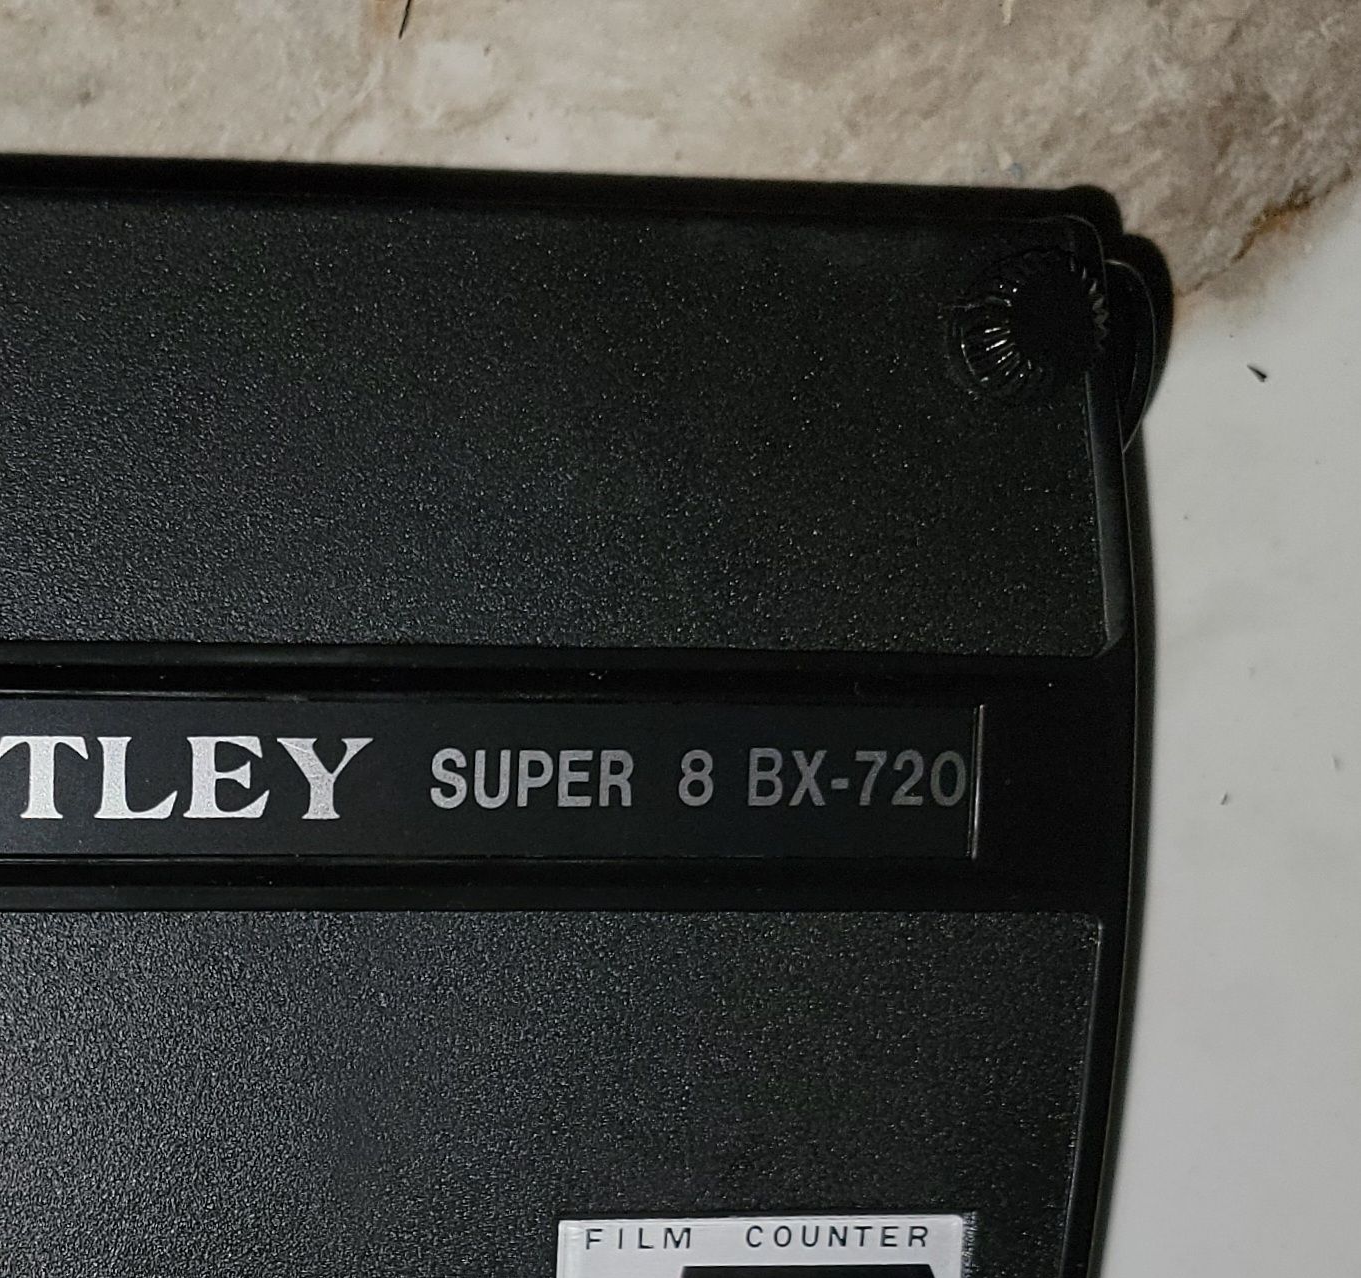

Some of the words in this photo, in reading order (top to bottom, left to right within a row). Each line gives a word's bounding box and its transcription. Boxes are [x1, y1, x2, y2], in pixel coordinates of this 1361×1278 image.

[430, 747, 635, 809] SUPER
[678, 749, 714, 806] 8
[748, 747, 967, 807] BX-720
[585, 1227, 692, 1250] FILM
[745, 1225, 929, 1248] COUNTER
